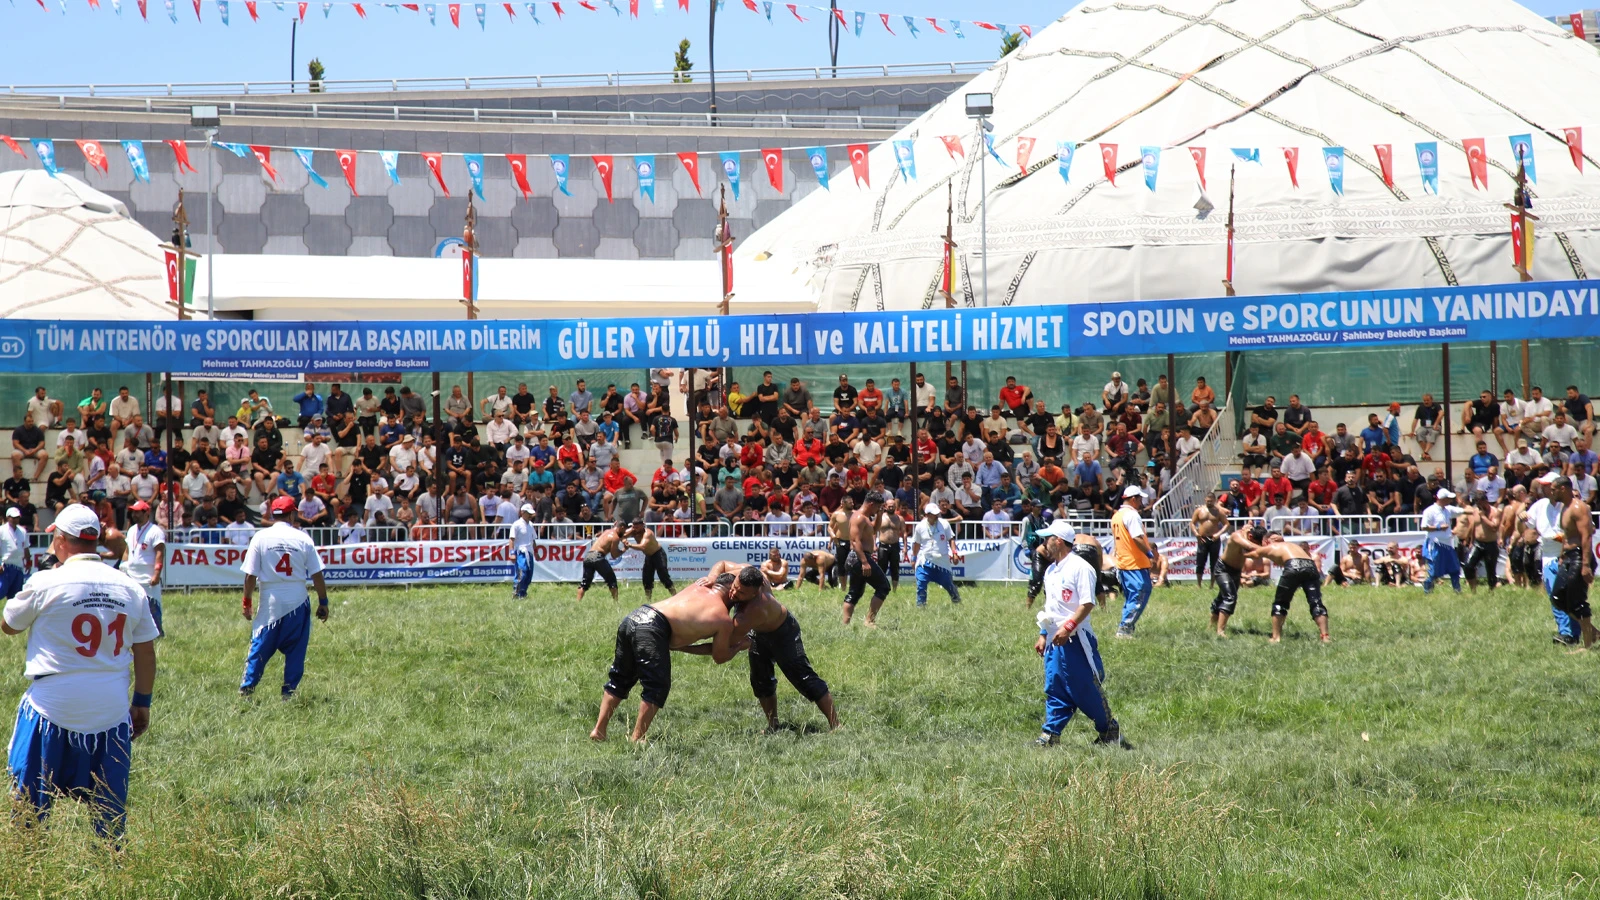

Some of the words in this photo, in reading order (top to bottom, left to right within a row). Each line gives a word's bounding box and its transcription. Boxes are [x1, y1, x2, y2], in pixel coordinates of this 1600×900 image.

[1083, 307, 1195, 337] SPORUN
[1203, 311, 1235, 332] ve
[1243, 296, 1424, 330] SPORCUNUN
[1, 341, 18, 353] 01
[36, 324, 74, 351] TÜM
[79, 325, 176, 351] ANTRENÖR
[181, 333, 201, 350] ve
[366, 329, 466, 354] BAŞARILAR
[471, 324, 541, 350] DİLERİM
[558, 321, 635, 360] GÜLER
[644, 319, 730, 362] YÜZLÜ,
[740, 322, 802, 356] HIZLI
[815, 329, 844, 356] ve
[854, 313, 962, 354] KALİTELİ
[972, 311, 1064, 350] HİZMET
[1229, 335, 1266, 345] Mehmet
[1267, 330, 1332, 343] TAHMAZOĞLU
[1342, 330, 1385, 341] Şahinbey
[1386, 328, 1428, 339] Belediye
[1429, 327, 1466, 338] Başkanı
[202, 358, 239, 368] Mehmet
[240, 357, 303, 369] TAHMAZOĞLU
[313, 358, 354, 370] Şahinbey
[355, 357, 394, 369] Belediye
[395, 358, 429, 369] Başkanı
[170, 549, 209, 566] ATA
[351, 544, 424, 567] GÜREŞİ
[712, 540, 782, 550] GELENEKSEL
[785, 538, 816, 550] YAĞLI
[275, 553, 293, 577] 4
[377, 568, 425, 579] Şahinbey
[427, 567, 471, 578] Belediye
[473, 566, 511, 577] Başkanı
[71, 612, 128, 658] 91
